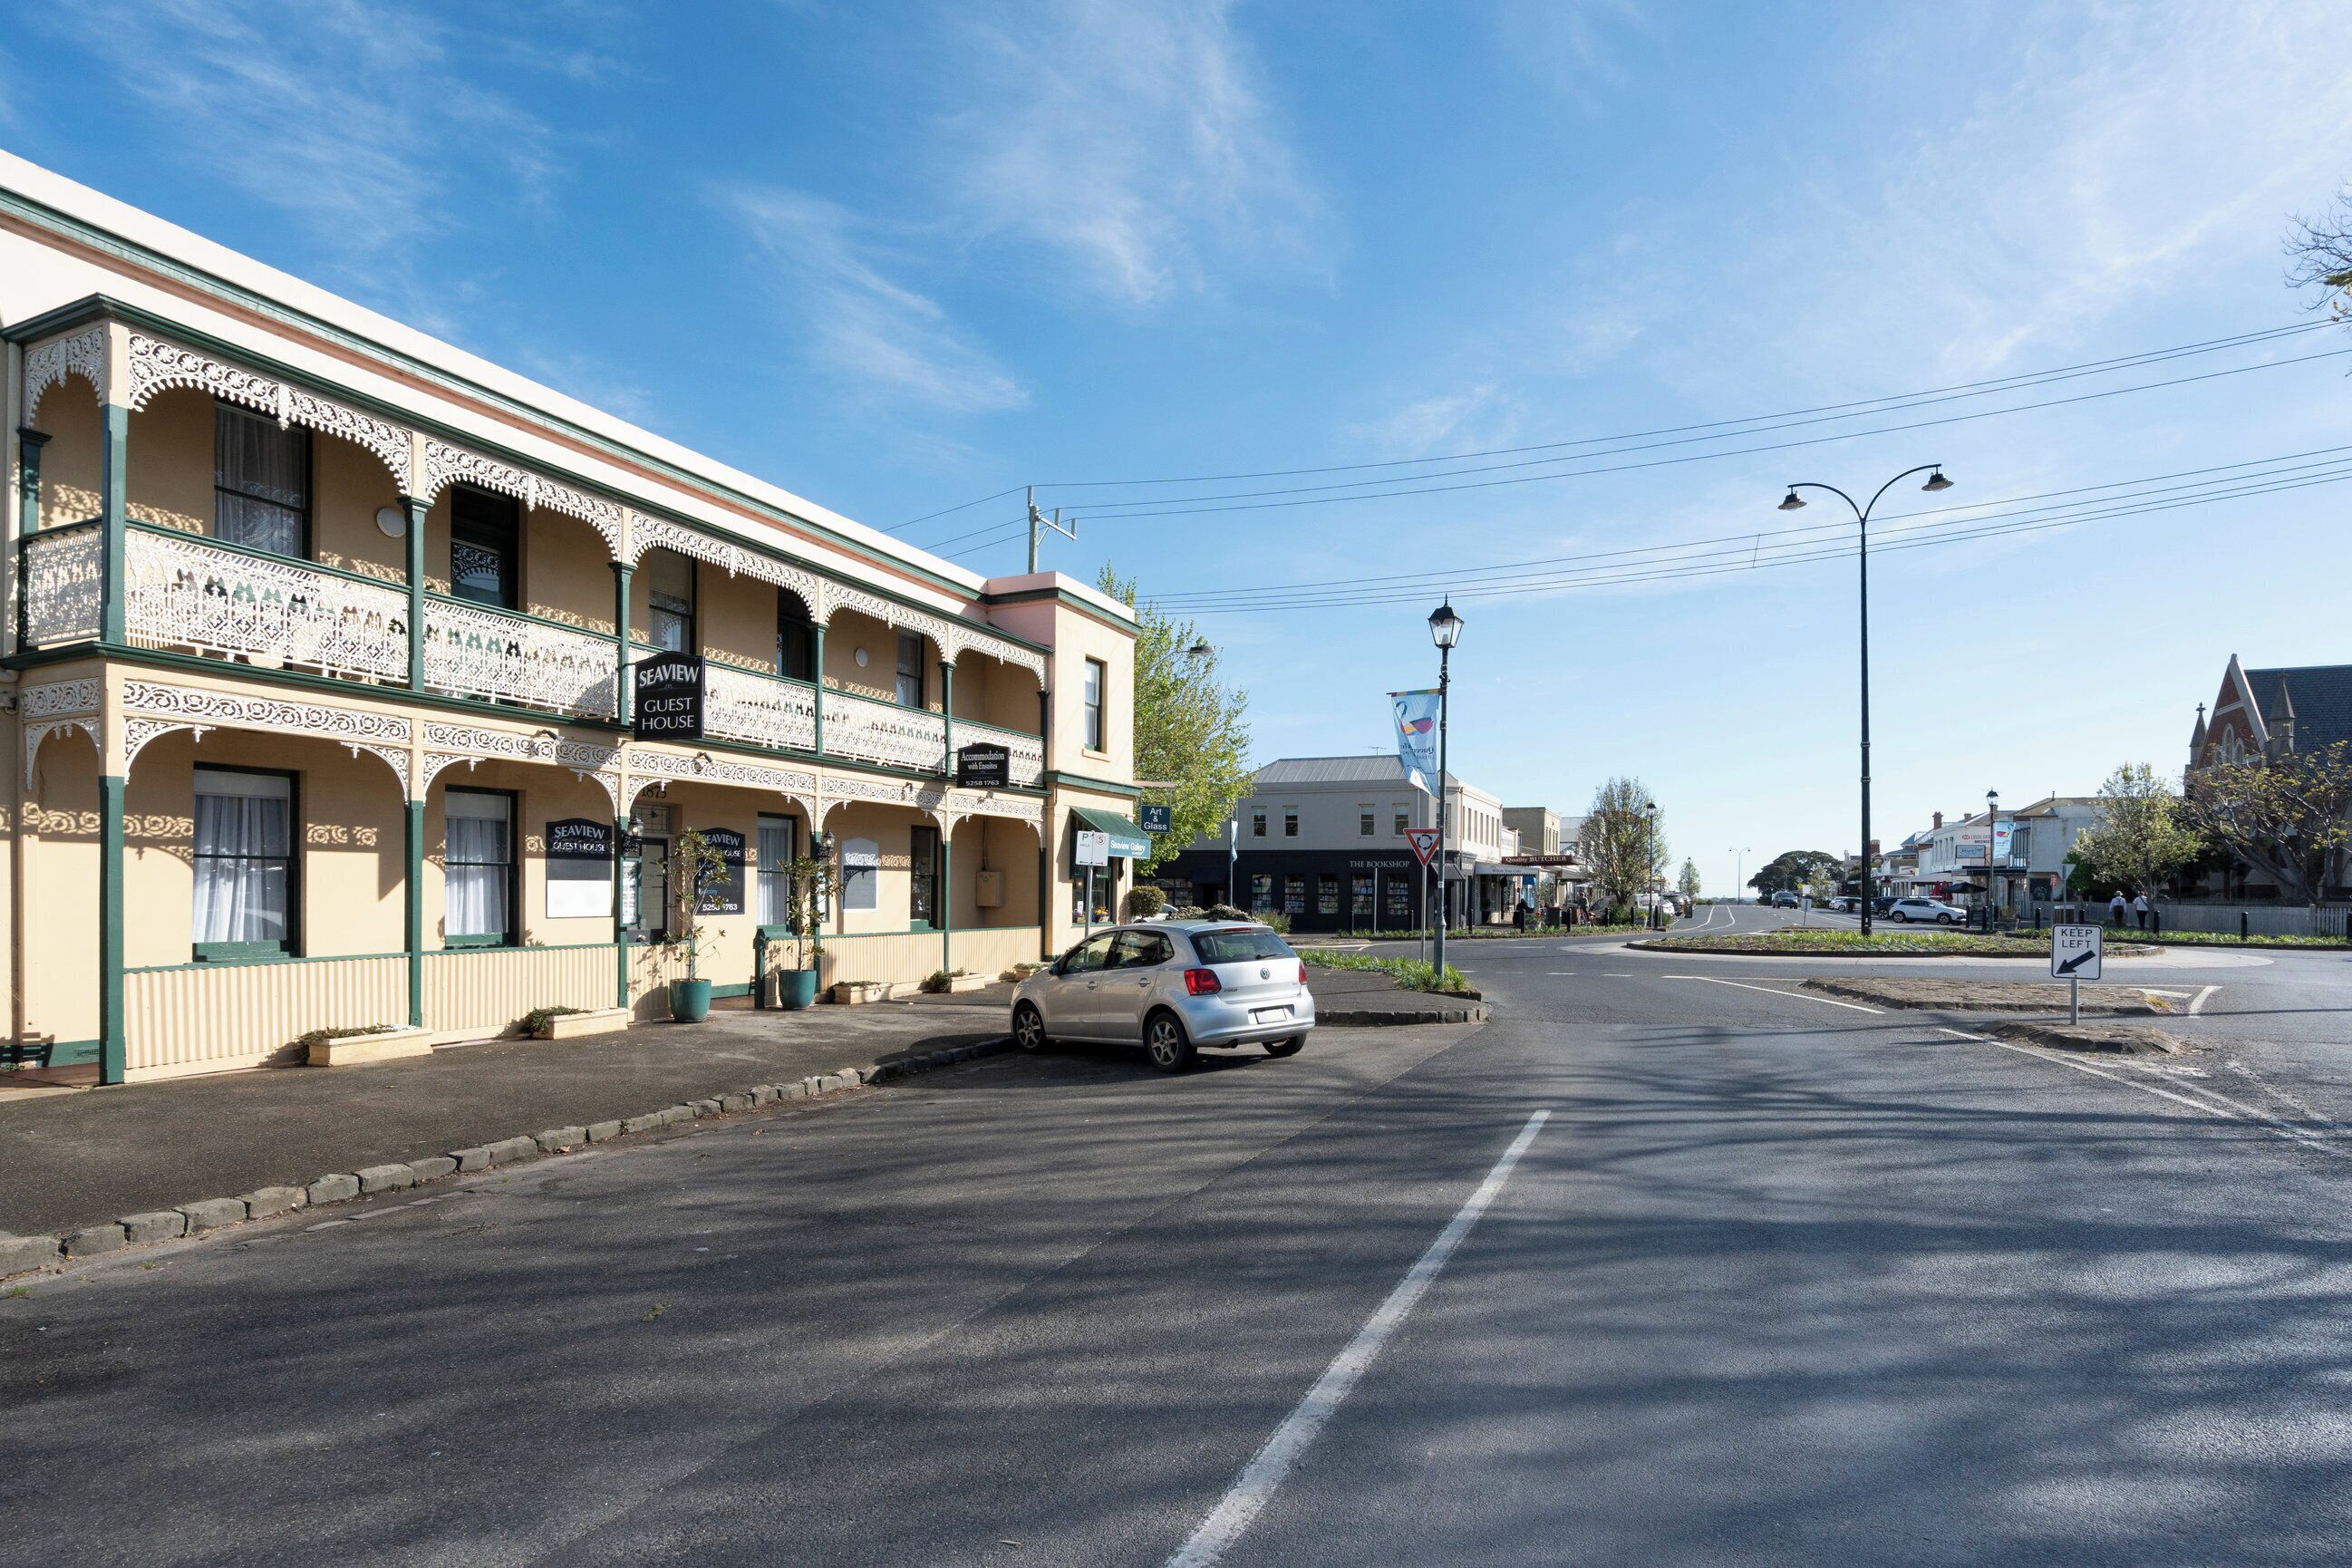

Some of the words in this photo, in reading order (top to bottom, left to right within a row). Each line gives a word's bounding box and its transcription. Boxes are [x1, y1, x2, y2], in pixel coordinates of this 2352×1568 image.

[638, 663, 700, 688] SEAVIEW
[644, 697, 692, 712] GUEST
[642, 715, 694, 731] HOUSE
[961, 750, 1005, 761] Accommodation
[967, 761, 979, 769] with
[979, 761, 998, 769] Ensuites
[1149, 808, 1162, 816] Art
[1144, 821, 1167, 830] Glass
[554, 825, 605, 839] SEAVIEW
[1081, 833, 1089, 841] P
[707, 834, 740, 847] EAVIEW
[553, 841, 577, 850] GUEST
[580, 843, 605, 852] HOUSE
[1110, 840, 1129, 850] Seaview
[1130, 842, 1146, 854] Gallery
[724, 849, 741, 857] OUSE
[1366, 860, 1410, 868] BOOKSHOP
[2061, 928, 2093, 937] KEEP
[2062, 940, 2091, 949] LEFT
